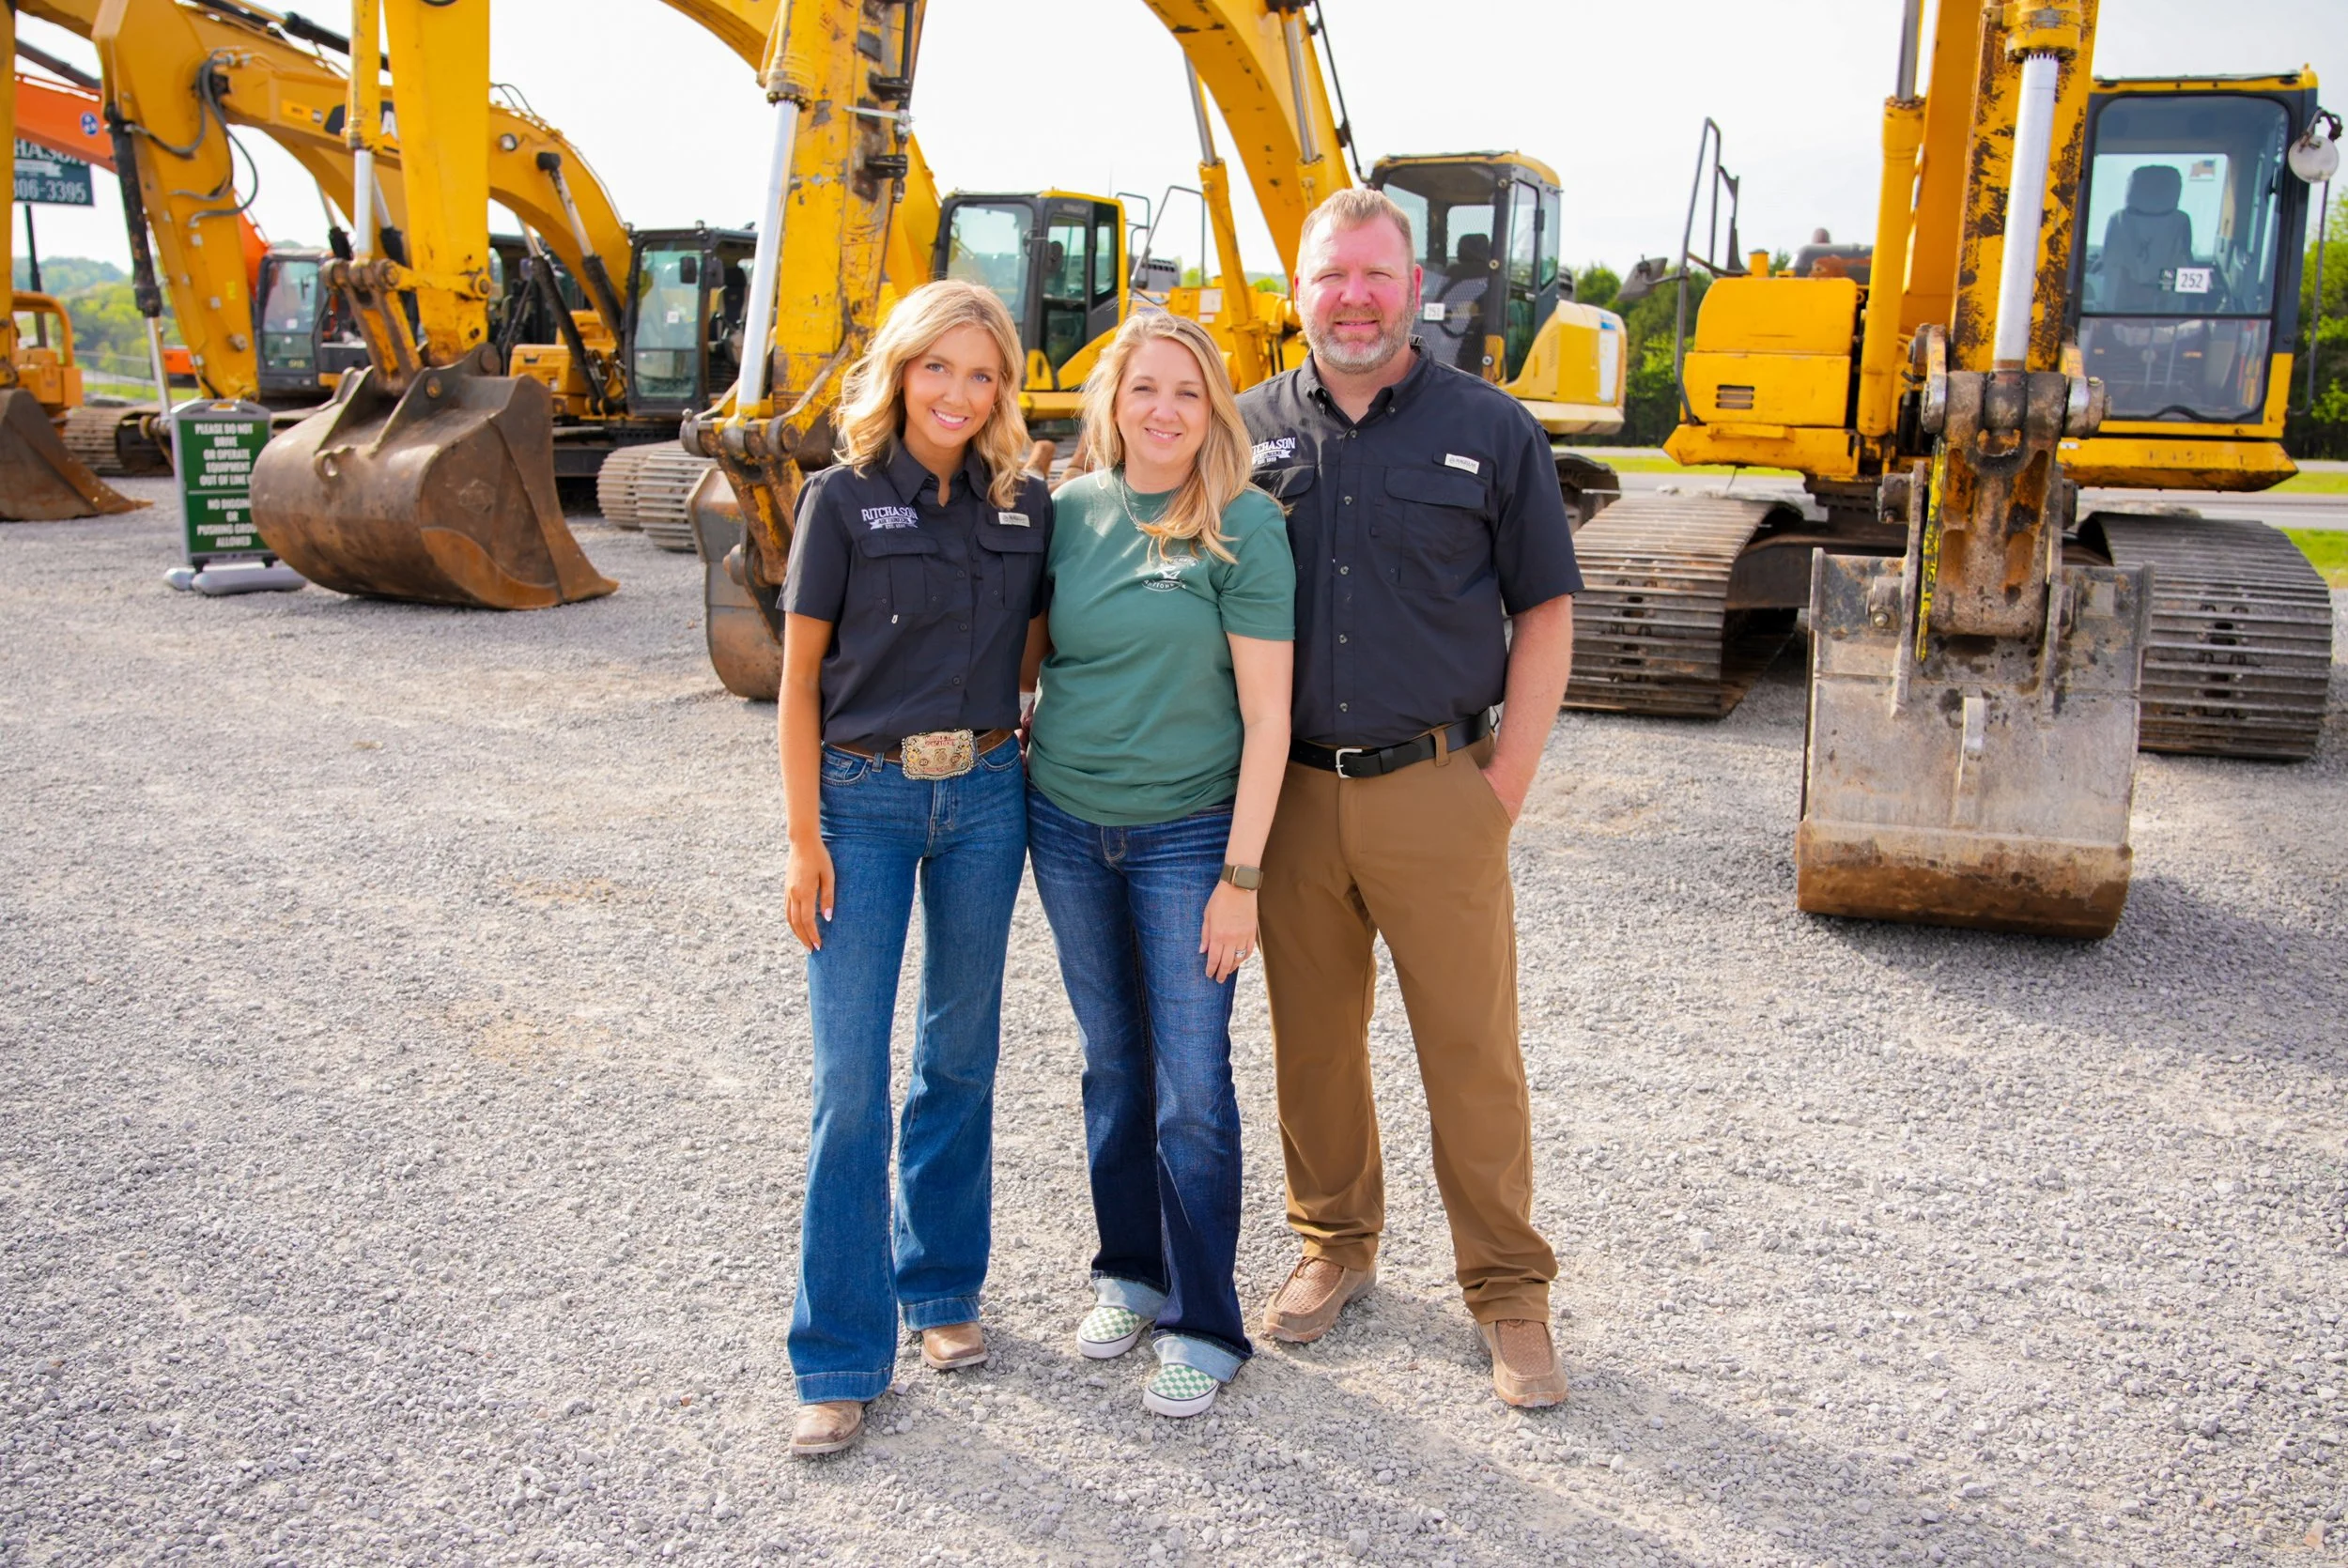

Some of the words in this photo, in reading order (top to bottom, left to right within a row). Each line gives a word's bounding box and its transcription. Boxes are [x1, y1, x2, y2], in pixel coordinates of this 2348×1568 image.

[2180, 272, 2203, 289] 252
[194, 423, 224, 436] PLEASE
[224, 423, 237, 435] DO
[237, 423, 254, 435] NOT
[213, 436, 239, 448] DRIVE
[203, 449, 216, 461] OR
[216, 448, 251, 461] OPERATE
[206, 461, 251, 473] EQUIPMENT
[199, 474, 217, 486] OUT
[217, 474, 228, 486] OF
[207, 498, 221, 510] NO
[225, 510, 239, 522] OR
[860, 506, 919, 521] RITCHASON
[196, 524, 234, 536] PUSHING
[215, 535, 253, 548] ALLOWED
